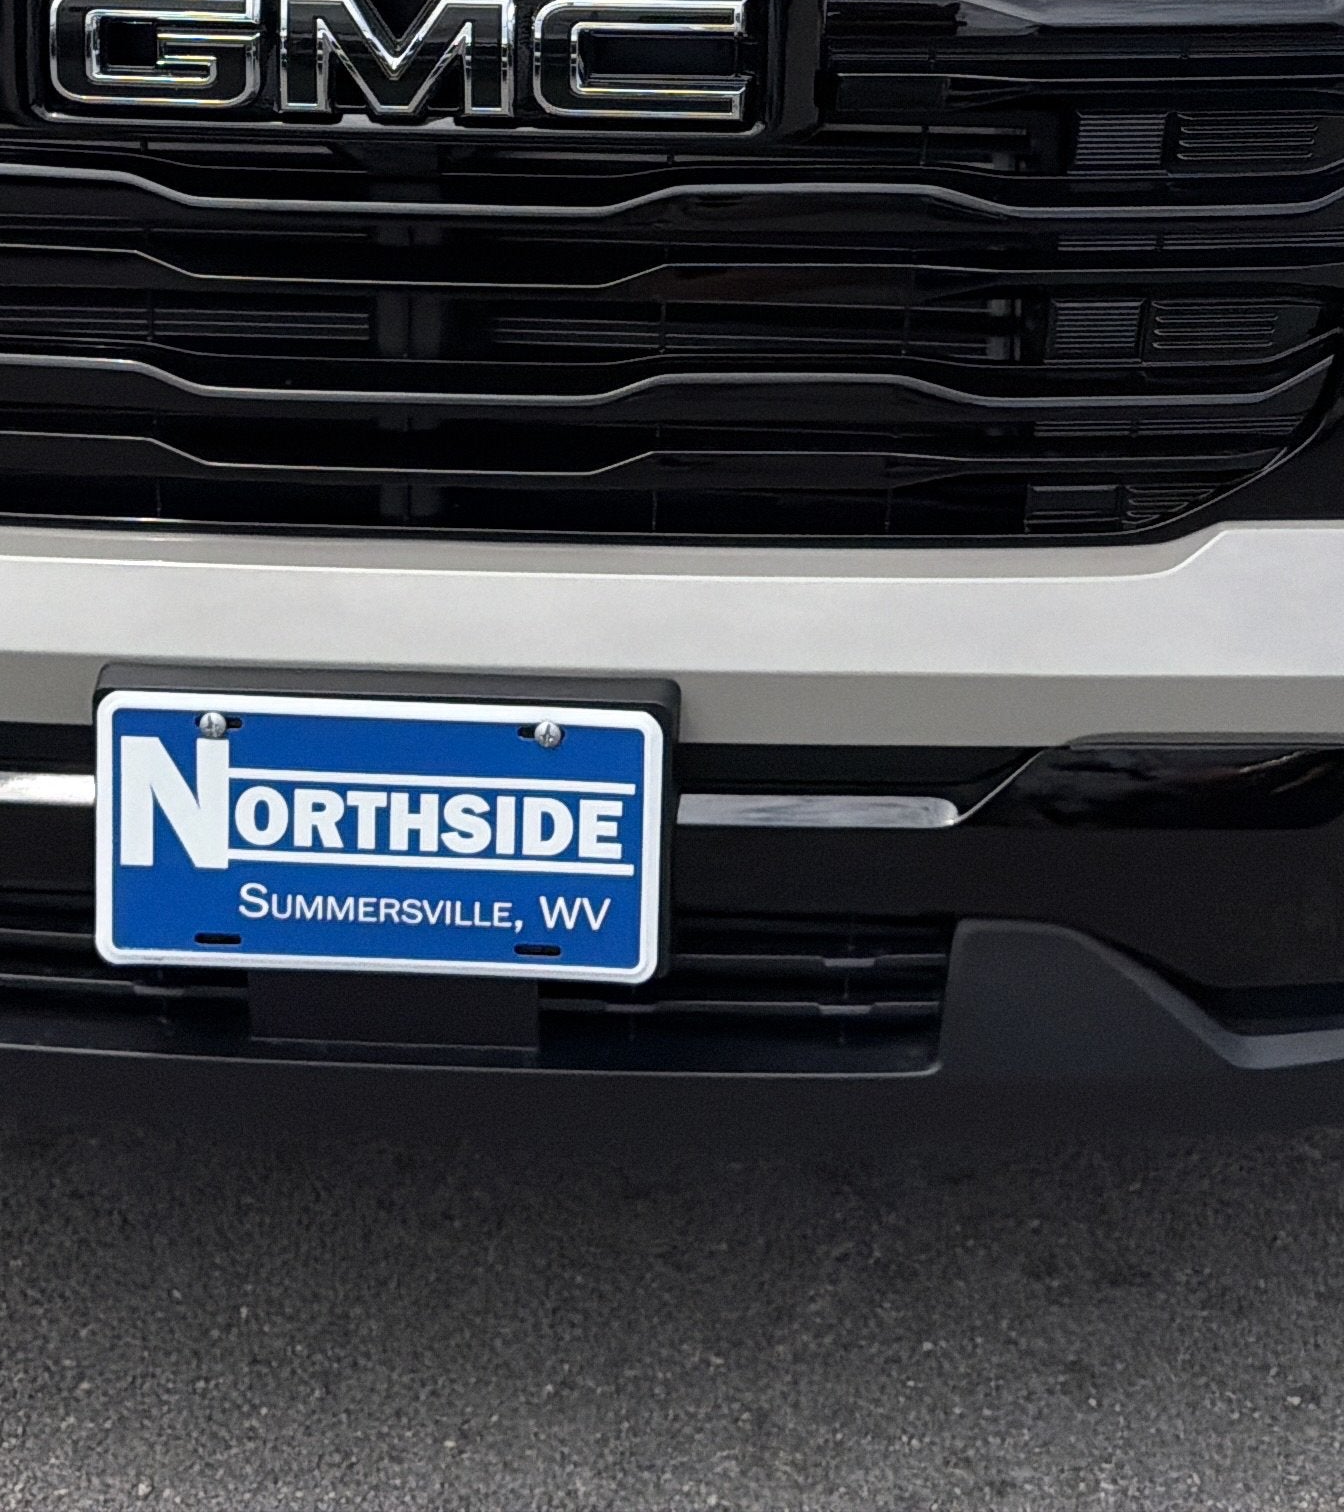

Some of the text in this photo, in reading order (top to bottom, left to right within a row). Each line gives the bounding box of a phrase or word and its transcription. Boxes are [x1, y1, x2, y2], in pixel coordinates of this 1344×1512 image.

[119, 734, 624, 870] NORTHSIDE
[238, 881, 612, 934] SUMMERSVILLE, WV
